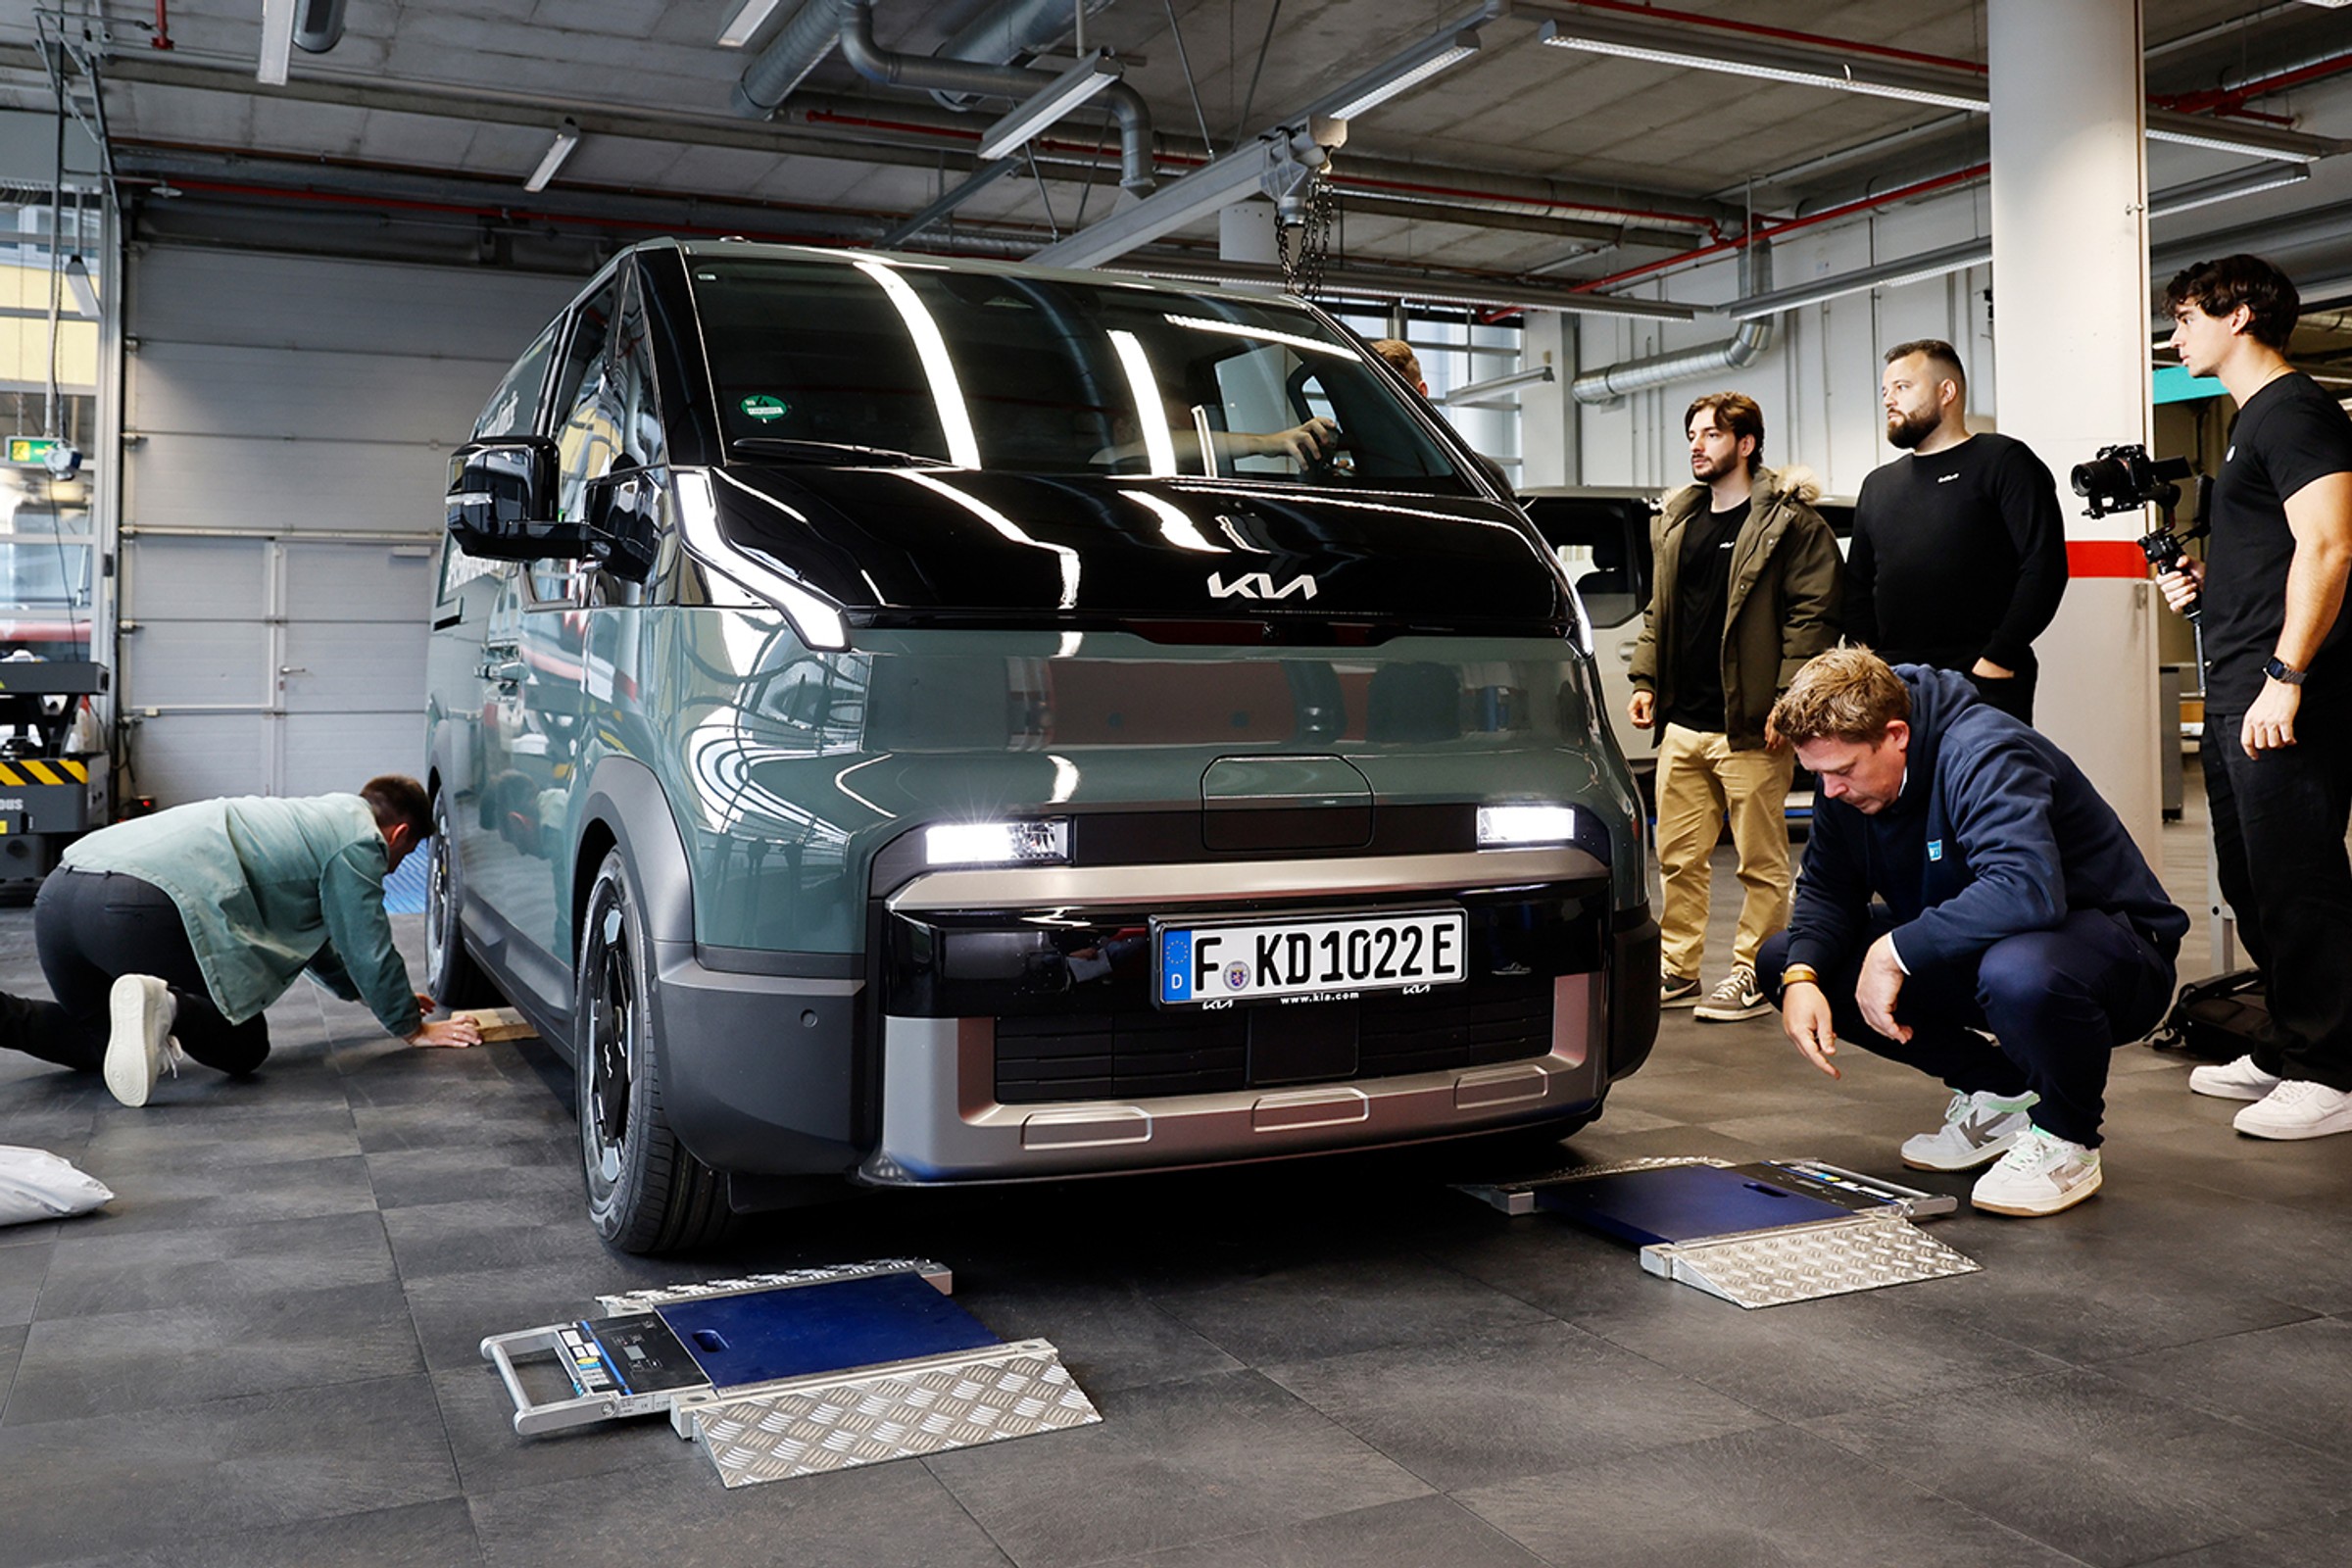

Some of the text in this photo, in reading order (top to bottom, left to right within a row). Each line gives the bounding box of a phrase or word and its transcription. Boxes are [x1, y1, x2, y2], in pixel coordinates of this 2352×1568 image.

[1207, 571, 1318, 600] KIA
[1195, 937, 1223, 992] F
[1171, 973, 1184, 990] D
[1280, 992, 1360, 1004] www.kia.com
